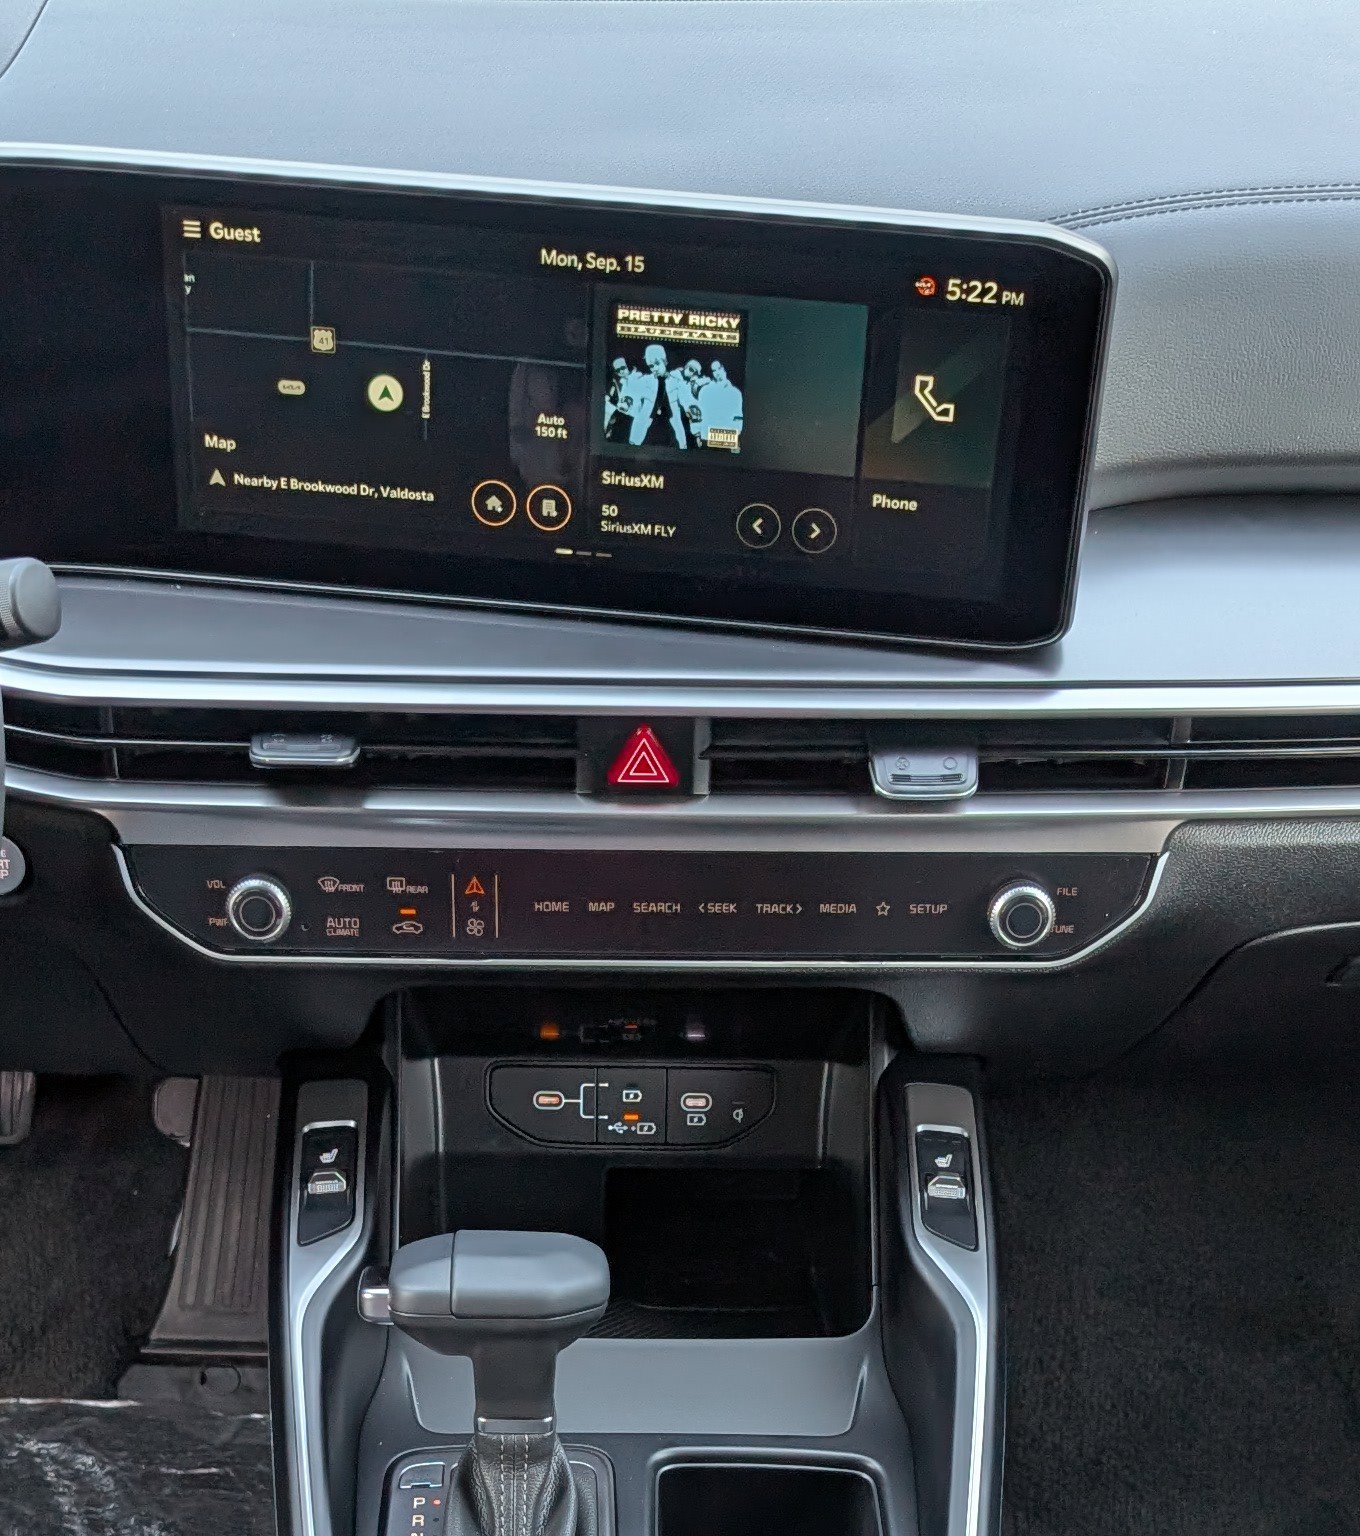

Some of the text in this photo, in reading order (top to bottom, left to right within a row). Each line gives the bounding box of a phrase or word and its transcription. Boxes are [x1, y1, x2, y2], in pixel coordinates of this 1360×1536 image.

[209, 221, 262, 243] Guest
[541, 248, 645, 273] Mon, Sep. 15
[946, 278, 1025, 306] 5:22 PM
[617, 308, 740, 329] PRETTY RICKY
[619, 325, 738, 341] BLUESTARS
[318, 337, 329, 346] 41
[537, 413, 565, 426] Auto
[535, 426, 568, 439] 150 ft
[204, 433, 237, 452] Map
[601, 470, 665, 489] SiriusXM
[233, 473, 434, 502] Nearby E Brookwood Dr, Valdosta
[872, 493, 918, 511] Phone
[601, 504, 618, 517] 50
[600, 520, 676, 537] SiriusXM FLY
[207, 880, 226, 889] VOL
[338, 884, 429, 894] FRONT REAR
[1056, 887, 1078, 896] FILE
[534, 902, 570, 912] HOME
[588, 902, 615, 912] MAP
[633, 902, 681, 913] SEARCH
[819, 903, 857, 914] MEDIA
[909, 903, 948, 914] SETUP
[326, 917, 360, 928] AUTO
[326, 929, 360, 937] CLIMATE
[413, 1497, 425, 1509] P
[412, 1515, 425, 1527] R
